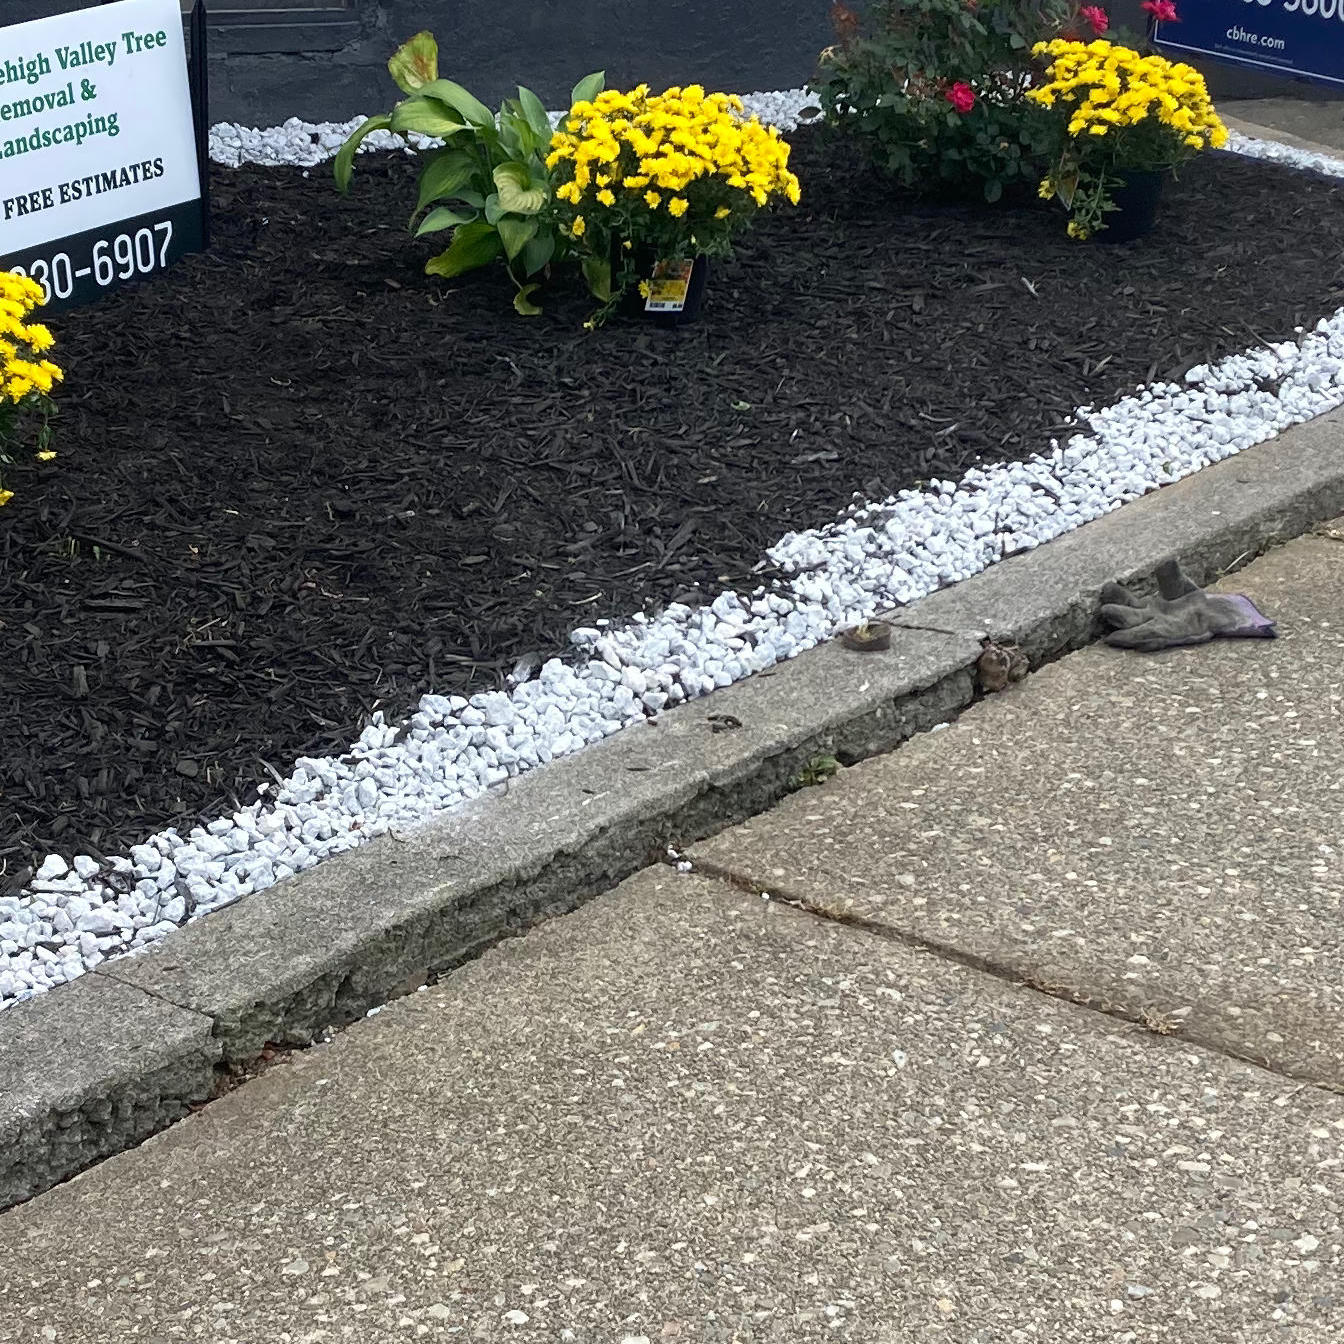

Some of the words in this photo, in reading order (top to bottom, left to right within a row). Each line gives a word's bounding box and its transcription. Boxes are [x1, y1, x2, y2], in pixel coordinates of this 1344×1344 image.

[55, 39, 117, 71] Valley
[121, 29, 167, 54] Tree
[1226, 26, 1285, 50] cbhre.com
[80, 78, 97, 101] &
[3, 189, 55, 220] FREE
[59, 158, 164, 203] ESTIMATES
[10, 221, 172, 305] 30-6907
